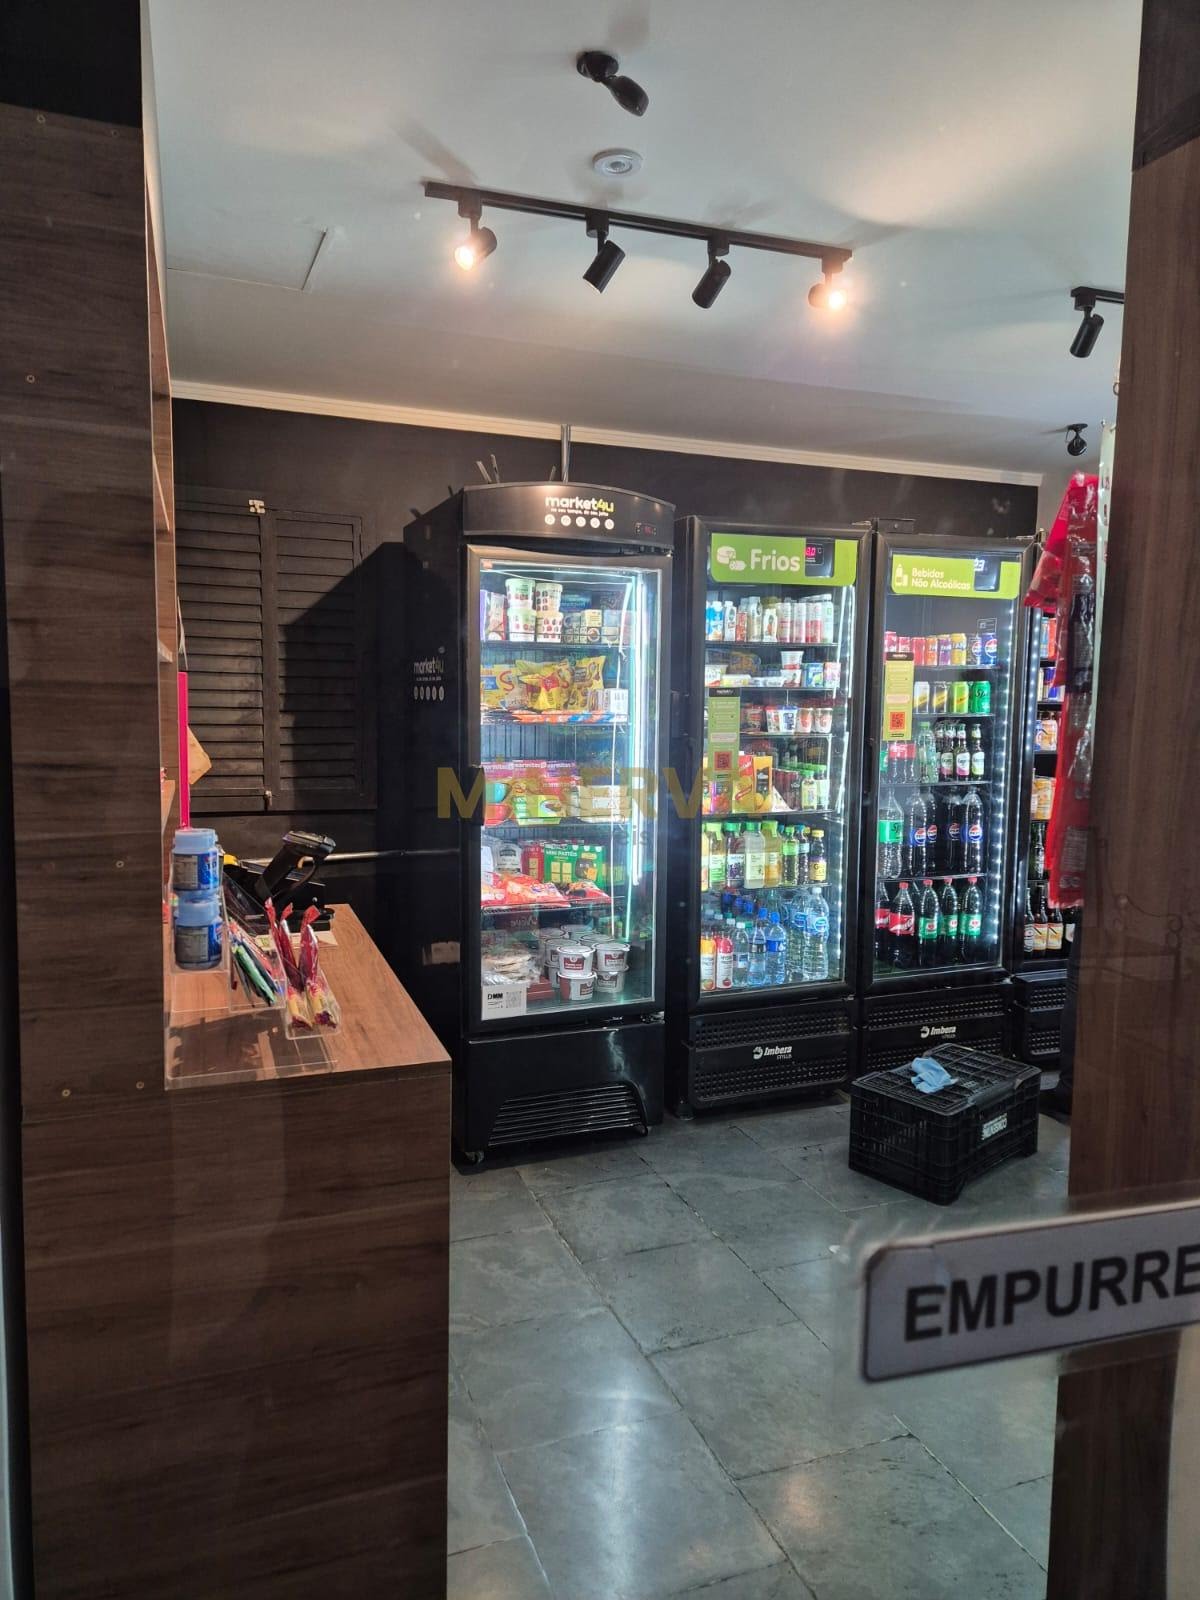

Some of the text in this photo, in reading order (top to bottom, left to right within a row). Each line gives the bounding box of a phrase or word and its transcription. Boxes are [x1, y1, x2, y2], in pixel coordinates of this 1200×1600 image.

[544, 496, 615, 513] market4u
[750, 549, 801, 572] Frios
[912, 567, 945, 579] Bebidas
[912, 578, 971, 590] Não Alcoólicas
[904, 1243, 1200, 1342] EMPURRE
